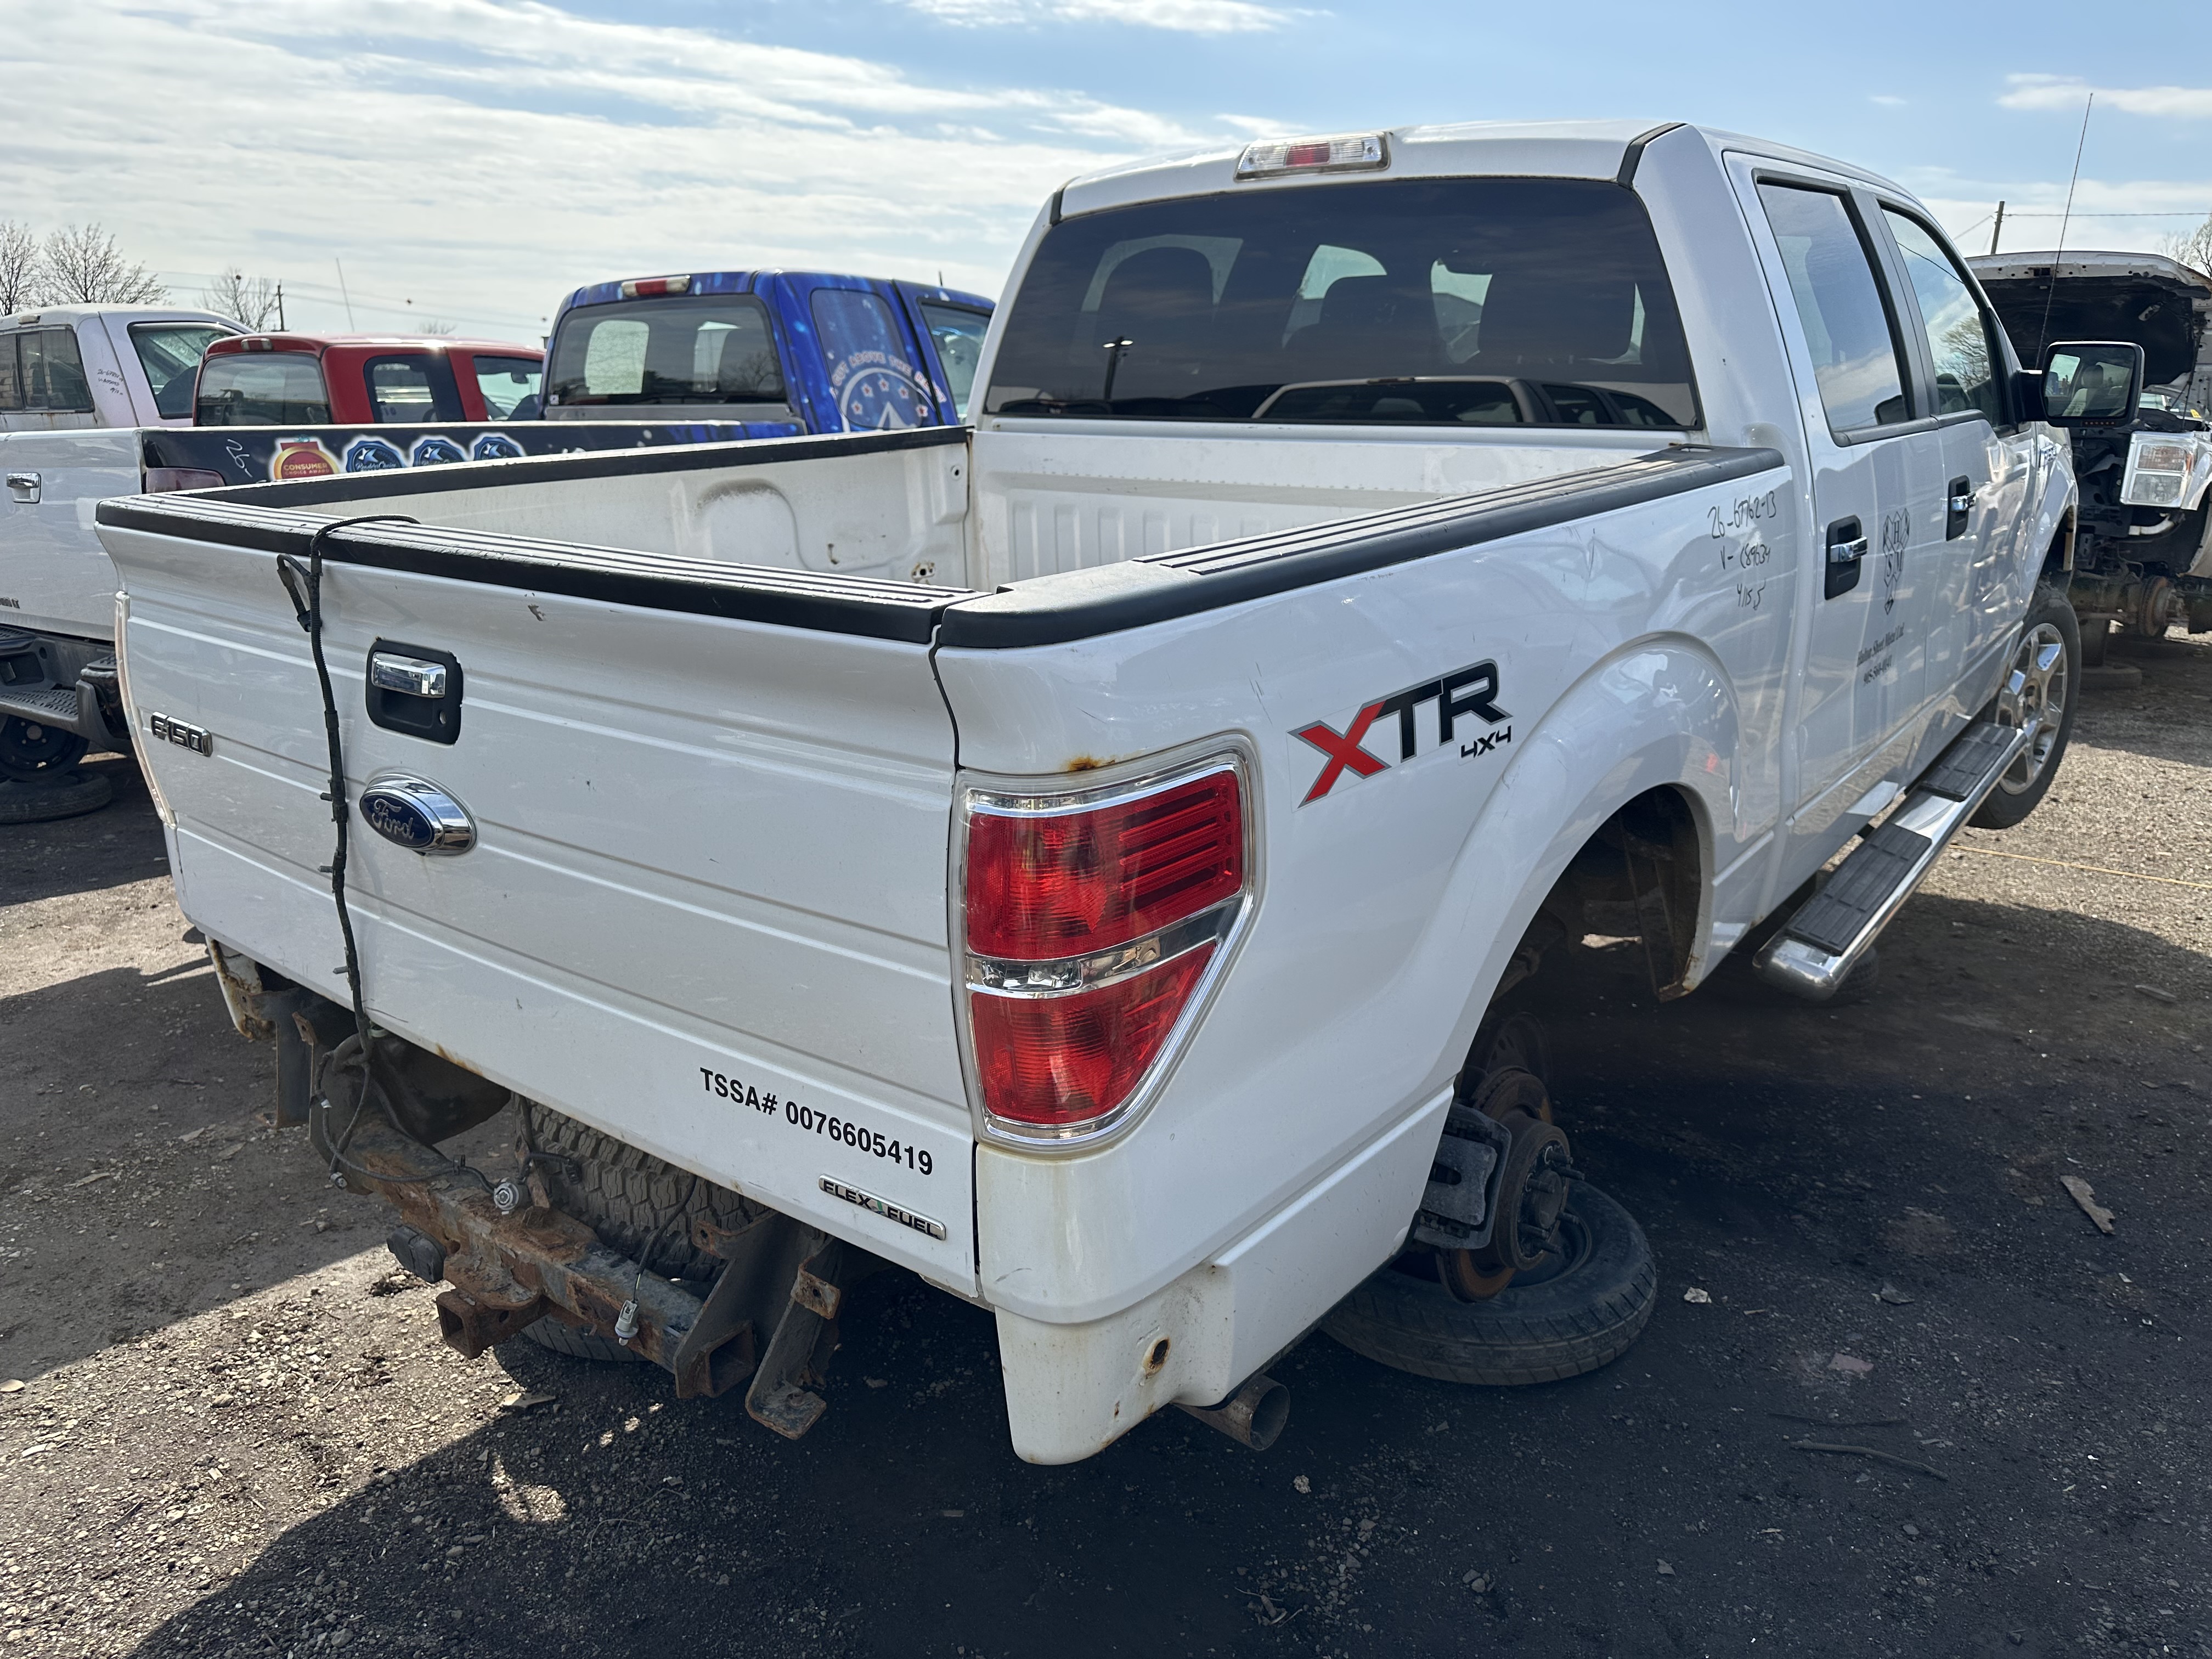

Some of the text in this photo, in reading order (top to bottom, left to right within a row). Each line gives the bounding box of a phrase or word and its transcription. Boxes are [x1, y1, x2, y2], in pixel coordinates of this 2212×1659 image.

[848, 351, 887, 368] ABOVE
[889, 355, 913, 377] THE
[284, 462, 328, 471] CONSUMER
[151, 712, 213, 757] F-150
[1287, 658, 1513, 809] XTR
[371, 798, 415, 840] Ford
[699, 1067, 933, 1175] TSSA# 0076605419
[823, 1179, 939, 1239] FLEX FUEL
